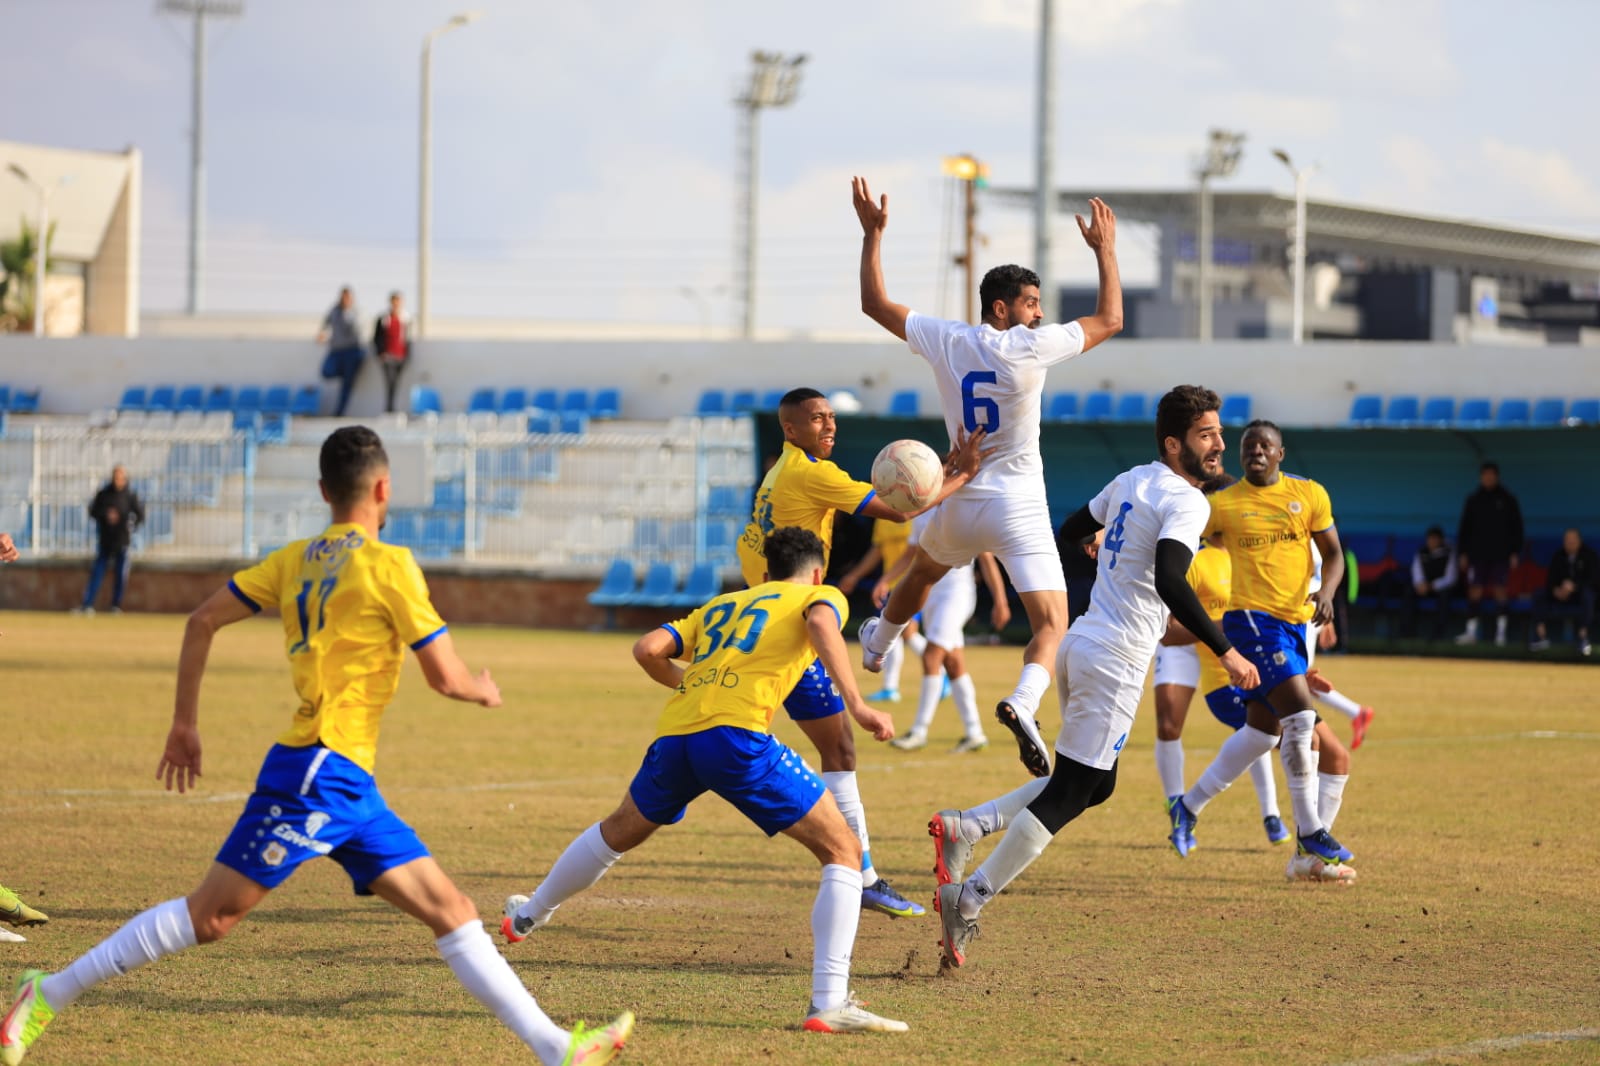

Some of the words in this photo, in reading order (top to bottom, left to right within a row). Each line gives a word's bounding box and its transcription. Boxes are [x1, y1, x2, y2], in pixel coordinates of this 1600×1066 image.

[962, 371, 999, 434] 6
[1105, 501, 1133, 570] 4
[290, 576, 337, 654] 17
[692, 593, 782, 664] 35
[1113, 733, 1126, 756] 4
